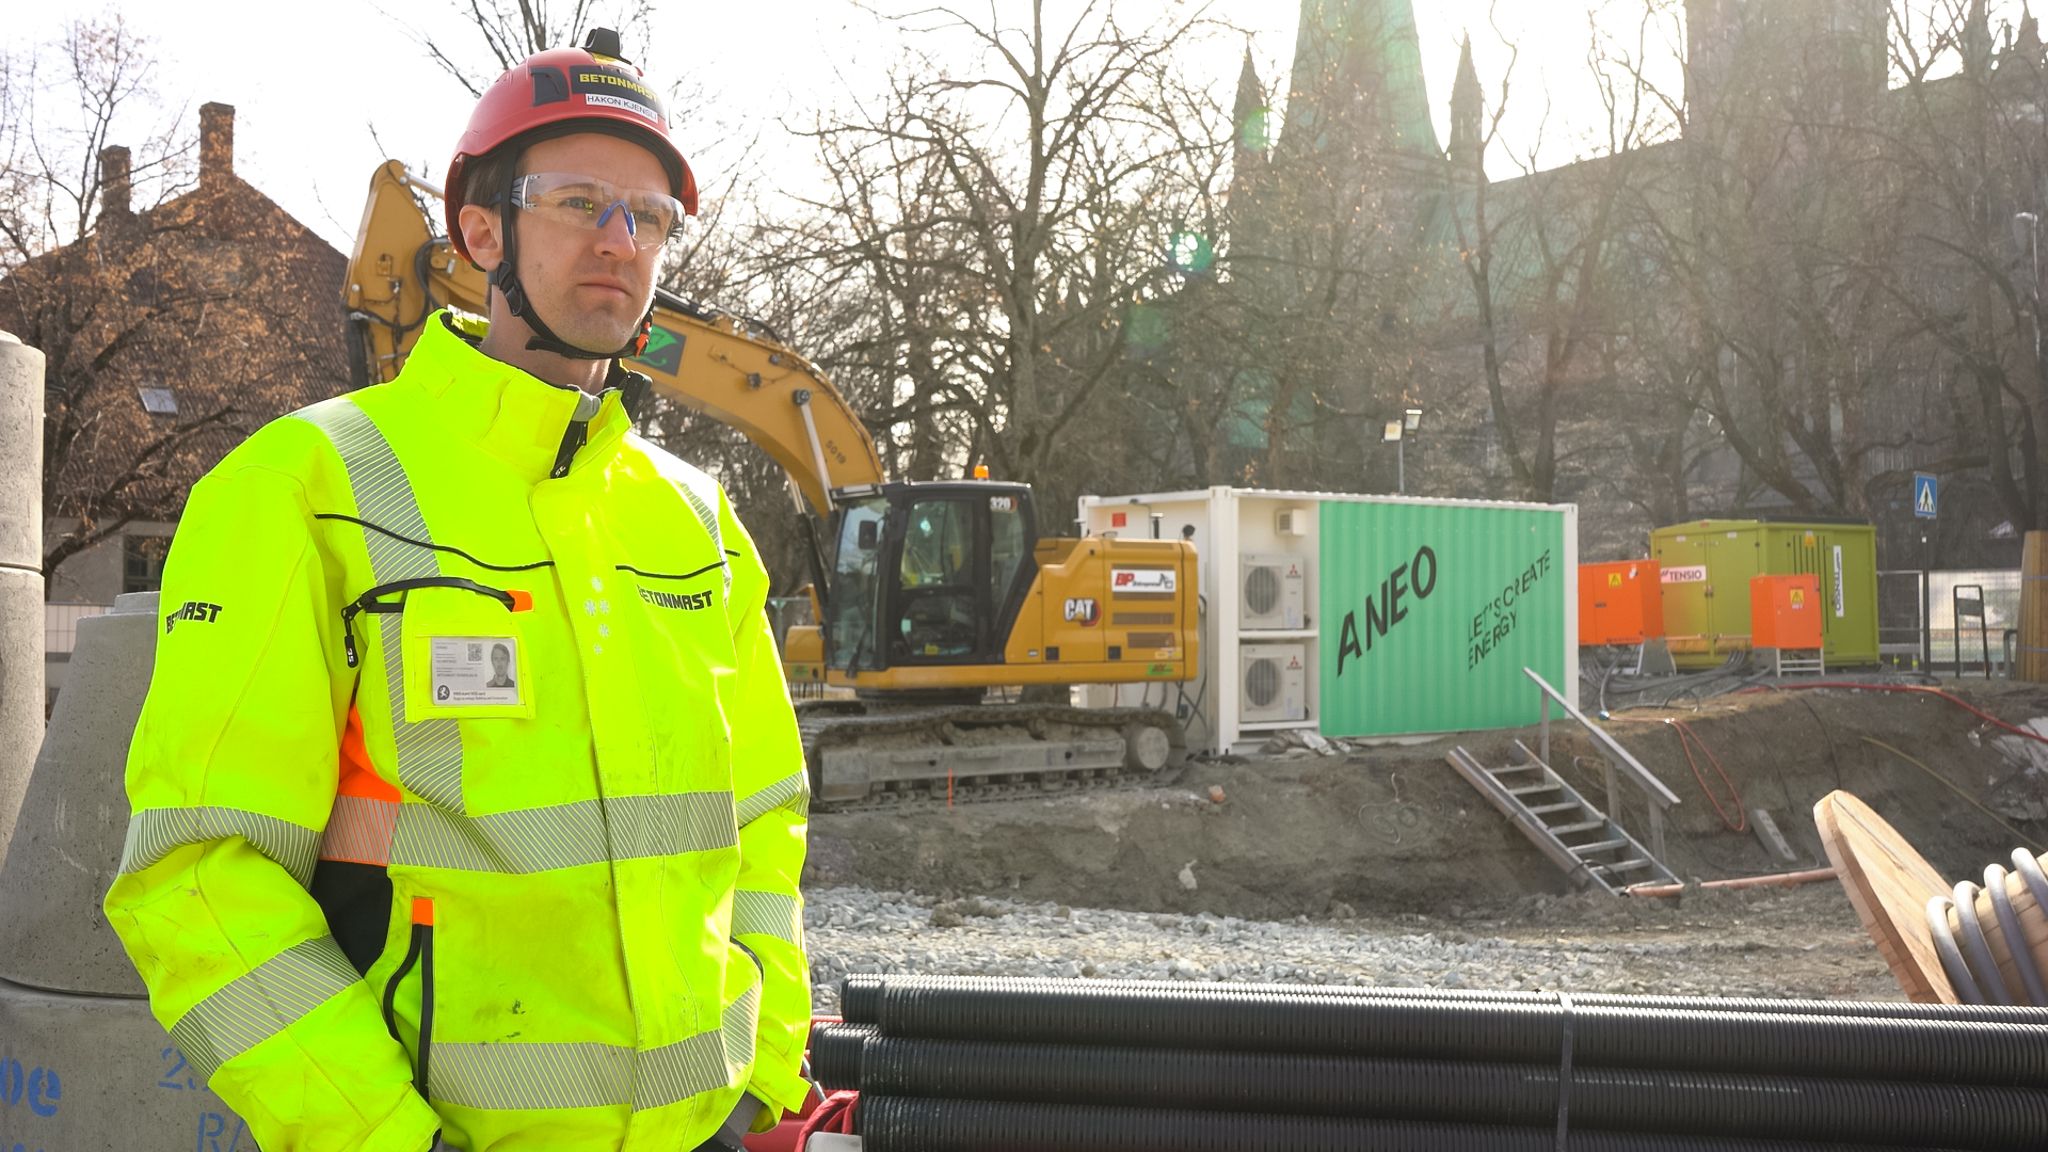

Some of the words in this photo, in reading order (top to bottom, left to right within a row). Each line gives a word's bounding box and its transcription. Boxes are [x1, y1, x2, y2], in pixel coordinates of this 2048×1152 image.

[579, 73, 657, 101] BETONMAST
[990, 496, 1011, 511] 320
[1669, 569, 1703, 581] TENSIO
[637, 584, 713, 611] ETONMAST
[1064, 598, 1094, 621] CAT
[1468, 597, 1501, 644] LET'S
[1503, 548, 1550, 607] CREATE
[1337, 545, 1437, 678] ANEO
[1468, 609, 1517, 672] ENERGY
